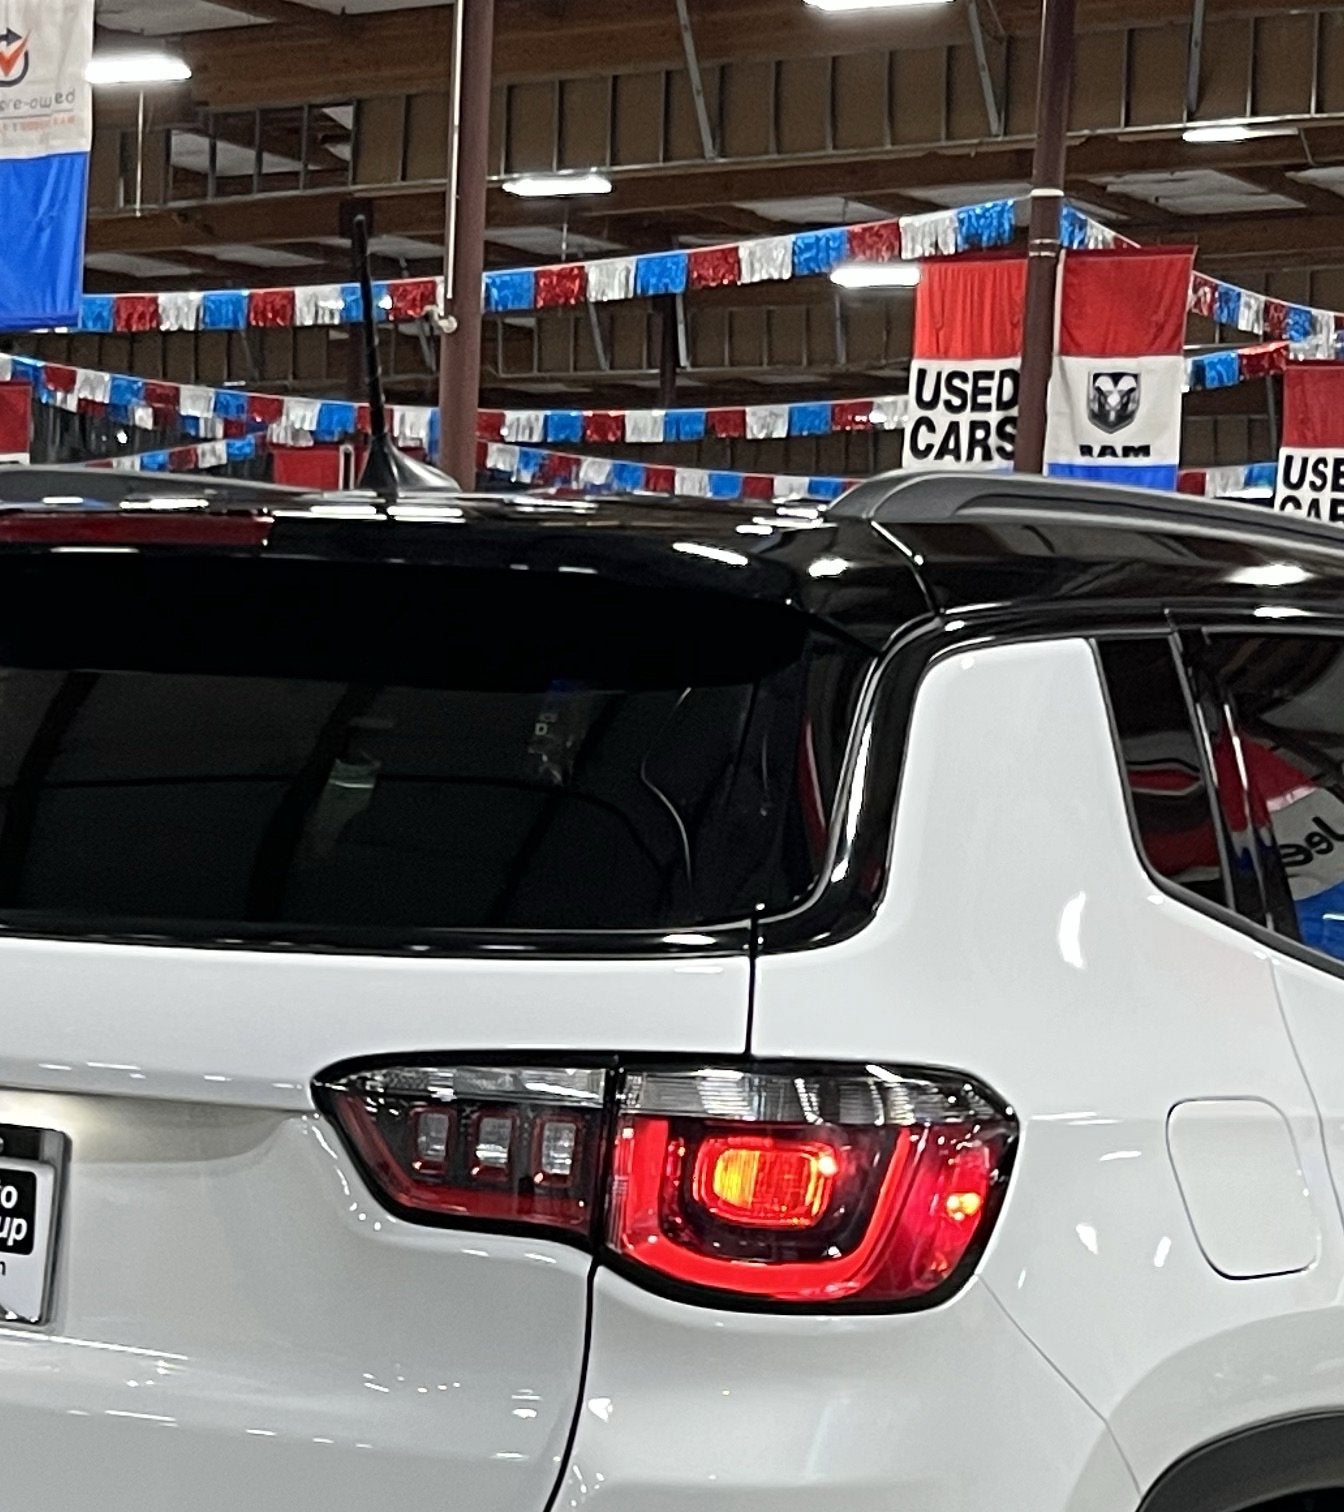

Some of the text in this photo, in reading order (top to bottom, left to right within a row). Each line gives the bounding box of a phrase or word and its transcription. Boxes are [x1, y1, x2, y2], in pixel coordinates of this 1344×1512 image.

[914, 367, 1021, 415] USED
[909, 415, 1017, 463] CARS
[1078, 444, 1151, 458] RAM
